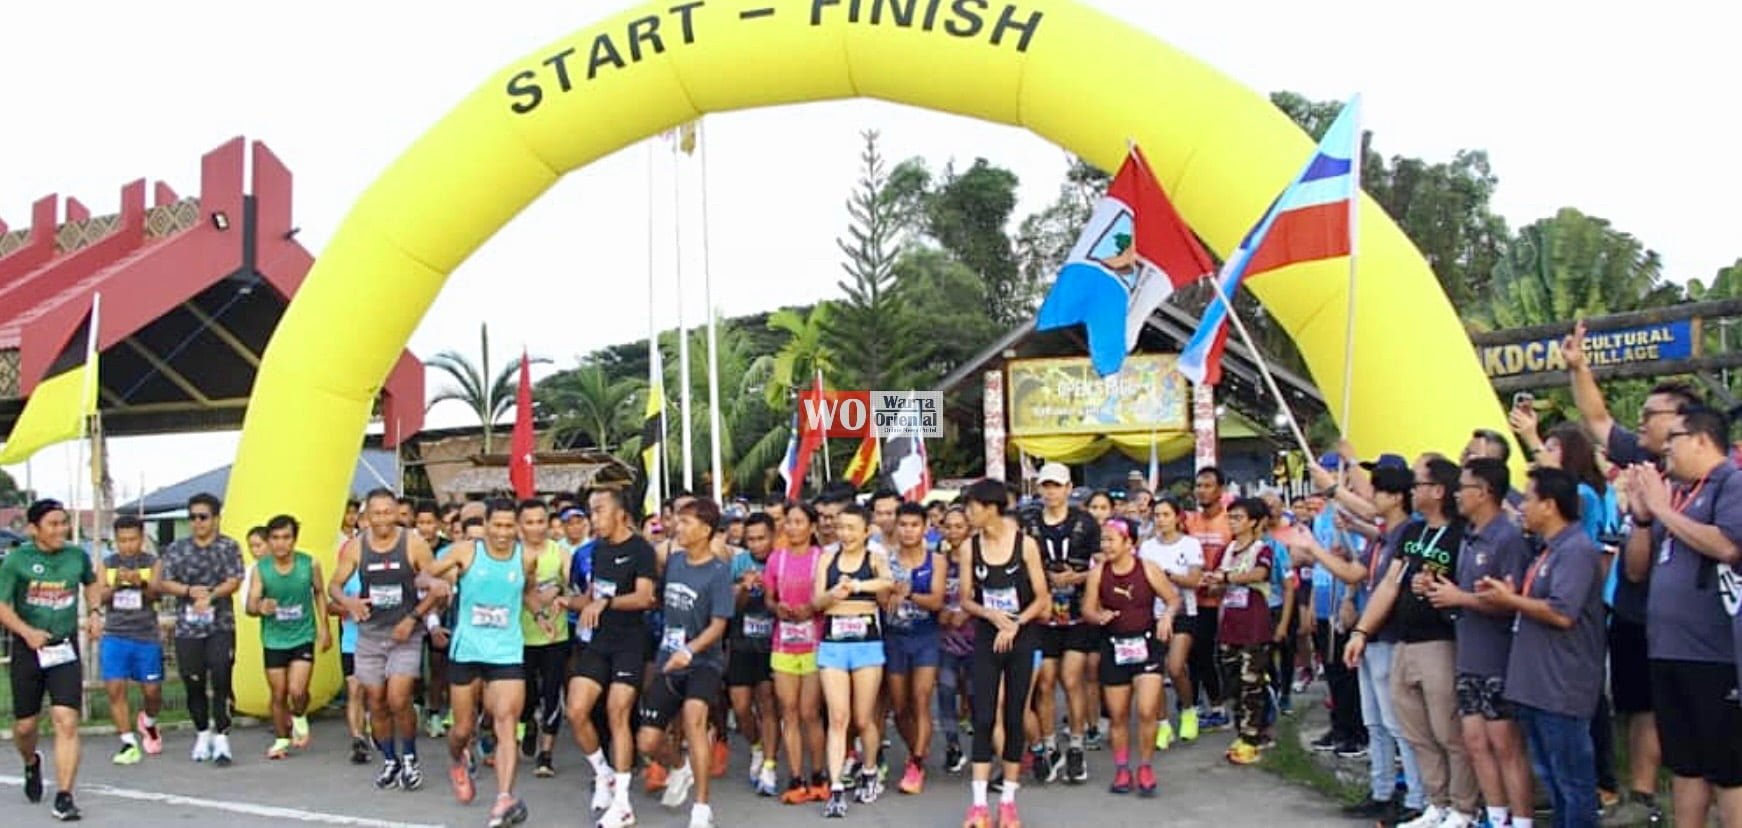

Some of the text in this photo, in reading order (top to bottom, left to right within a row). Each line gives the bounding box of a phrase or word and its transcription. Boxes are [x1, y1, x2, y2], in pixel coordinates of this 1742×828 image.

[505, 1, 702, 114] START
[809, 0, 1044, 53] FINISH
[1581, 327, 1675, 351] CULTURAL
[1484, 340, 1567, 377] KDCA
[1581, 344, 1659, 365] VILLAGE
